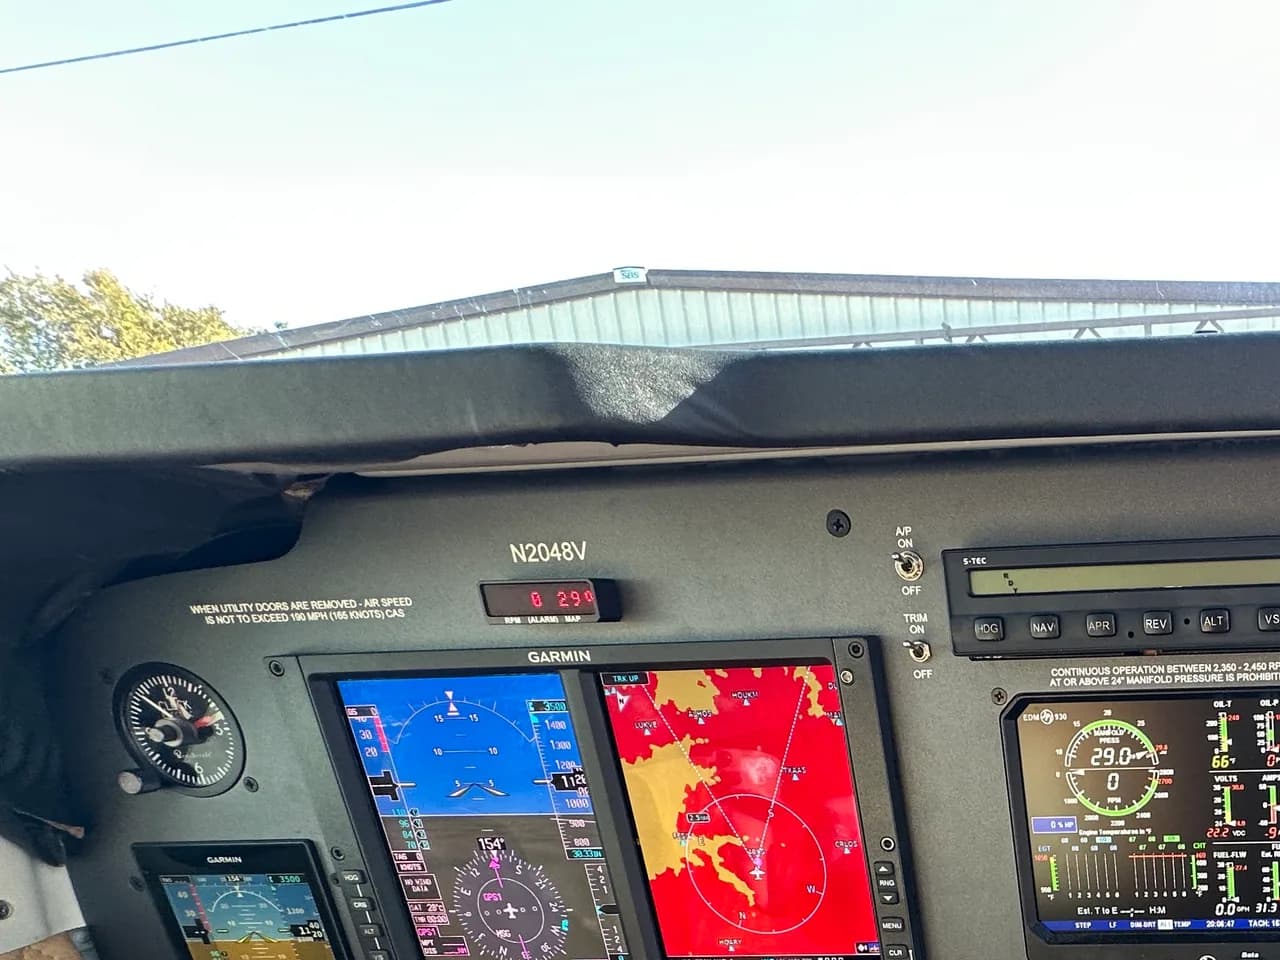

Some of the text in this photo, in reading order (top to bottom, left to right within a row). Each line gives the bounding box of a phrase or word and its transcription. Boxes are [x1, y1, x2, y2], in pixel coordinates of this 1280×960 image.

[896, 527, 912, 536] A/P
[898, 539, 913, 548] ON
[510, 541, 586, 563] N2048V
[902, 586, 922, 595] OFF
[190, 597, 413, 614] WHEN UTILITY DOORS ARE REMOVED AIR SPEED
[205, 608, 405, 625] IS NOT TO EXCEED 190 MPH (165 KNOTS) CAS
[903, 614, 928, 623] TRIM
[1204, 616, 1224, 626] ALT
[1265, 614, 1280, 624] VS
[1033, 623, 1055, 633] NAV
[1146, 619, 1167, 629] REV
[909, 625, 925, 634] ON
[528, 650, 591, 663] GARMIN
[913, 670, 933, 679] OFF
[1050, 665, 1110, 677] CONTINUOUS
[1112, 664, 1165, 675] OPERATION
[1167, 663, 1211, 673] BETWEEN
[1213, 662, 1236, 672] 2,350
[1243, 662, 1267, 672] 2,450
[1049, 675, 1064, 687] AT
[1066, 675, 1080, 686] OR
[1083, 675, 1109, 685] ABOVE
[1110, 674, 1124, 684] 24"
[1126, 673, 1173, 684] MANIFOLD
[1175, 672, 1223, 684] PRESSURE
[1225, 672, 1234, 682] IS
[1090, 748, 1131, 766] 29.0
[1212, 756, 1229, 768] 66
[1107, 772, 1119, 790] 0
[1207, 828, 1229, 837] 22.2
[482, 893, 502, 901] GPS1
[882, 922, 902, 930] MENU
